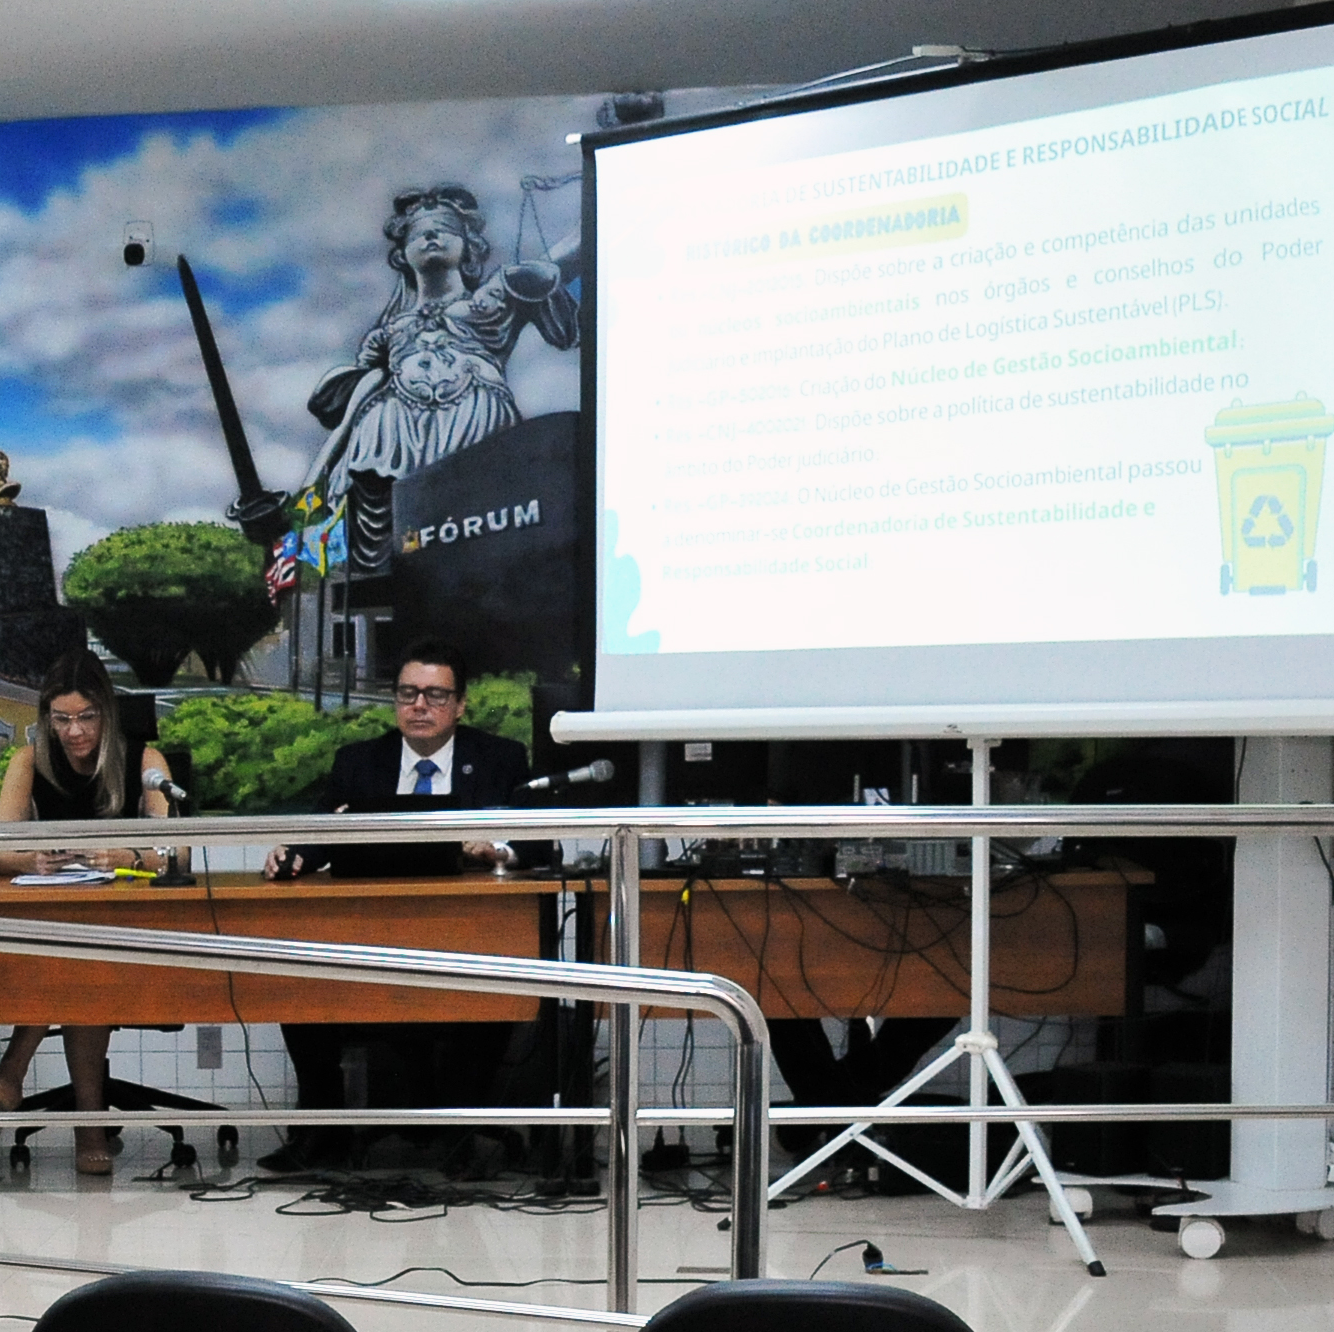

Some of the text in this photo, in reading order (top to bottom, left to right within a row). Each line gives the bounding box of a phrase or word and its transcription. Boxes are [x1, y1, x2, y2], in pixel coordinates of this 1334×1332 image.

[812, 151, 1000, 200] SUSTENTABILIDADE
[1007, 149, 1017, 168] E
[1022, 107, 1248, 165] RESPONSABILIDADE
[1251, 96, 1330, 125] SOCIAL
[779, 228, 802, 250] DA
[809, 205, 960, 244] COORDENADORIA
[815, 265, 871, 287] Dispõe
[878, 252, 926, 278] sobre
[932, 256, 944, 271] a
[949, 241, 1017, 268] criação
[1024, 240, 1035, 256] e
[1041, 218, 1169, 253] competência
[1177, 211, 1216, 235] das
[1224, 196, 1321, 227] unidades
[775, 290, 920, 327] socioambientais
[935, 289, 970, 308] nos
[984, 275, 1051, 304] órgãos
[1066, 274, 1078, 289] e
[1093, 255, 1195, 286] conselhos
[1213, 247, 1243, 270] do
[1262, 236, 1324, 262] Poder
[739, 353, 749, 366] e
[753, 337, 854, 365] implantação
[857, 337, 879, 354] do
[883, 329, 934, 351] Plano
[938, 323, 960, 342] de
[965, 313, 1049, 342] Logística
[1053, 295, 1169, 329] Sustentável
[1172, 289, 1230, 318] (PLS).
[800, 375, 860, 398] Criação
[864, 374, 887, 390] do
[891, 365, 959, 388] Núcleo
[964, 360, 988, 379] de
[993, 352, 1063, 376] Gestão
[815, 410, 873, 433] Dispõe
[877, 404, 928, 428] sobre
[933, 405, 943, 420] a
[947, 394, 1014, 421] política
[1019, 390, 1043, 410] de
[1048, 373, 1215, 409] sustentabilidade
[1220, 371, 1250, 390] no
[722, 456, 743, 474] do
[747, 452, 792, 470] Poder
[798, 487, 810, 504] O
[815, 483, 875, 503] Núcleo
[879, 480, 901, 498] de
[905, 474, 969, 496] Gestão
[973, 460, 1123, 491] Socioambiental
[1128, 457, 1202, 484] passou
[420, 499, 540, 549] FÓRUM
[792, 515, 929, 540] Coordenadoria
[934, 512, 958, 531] de
[963, 499, 1138, 529] Sustentabilidade
[1143, 501, 1156, 516] e
[663, 558, 810, 582] Responsabilidade
